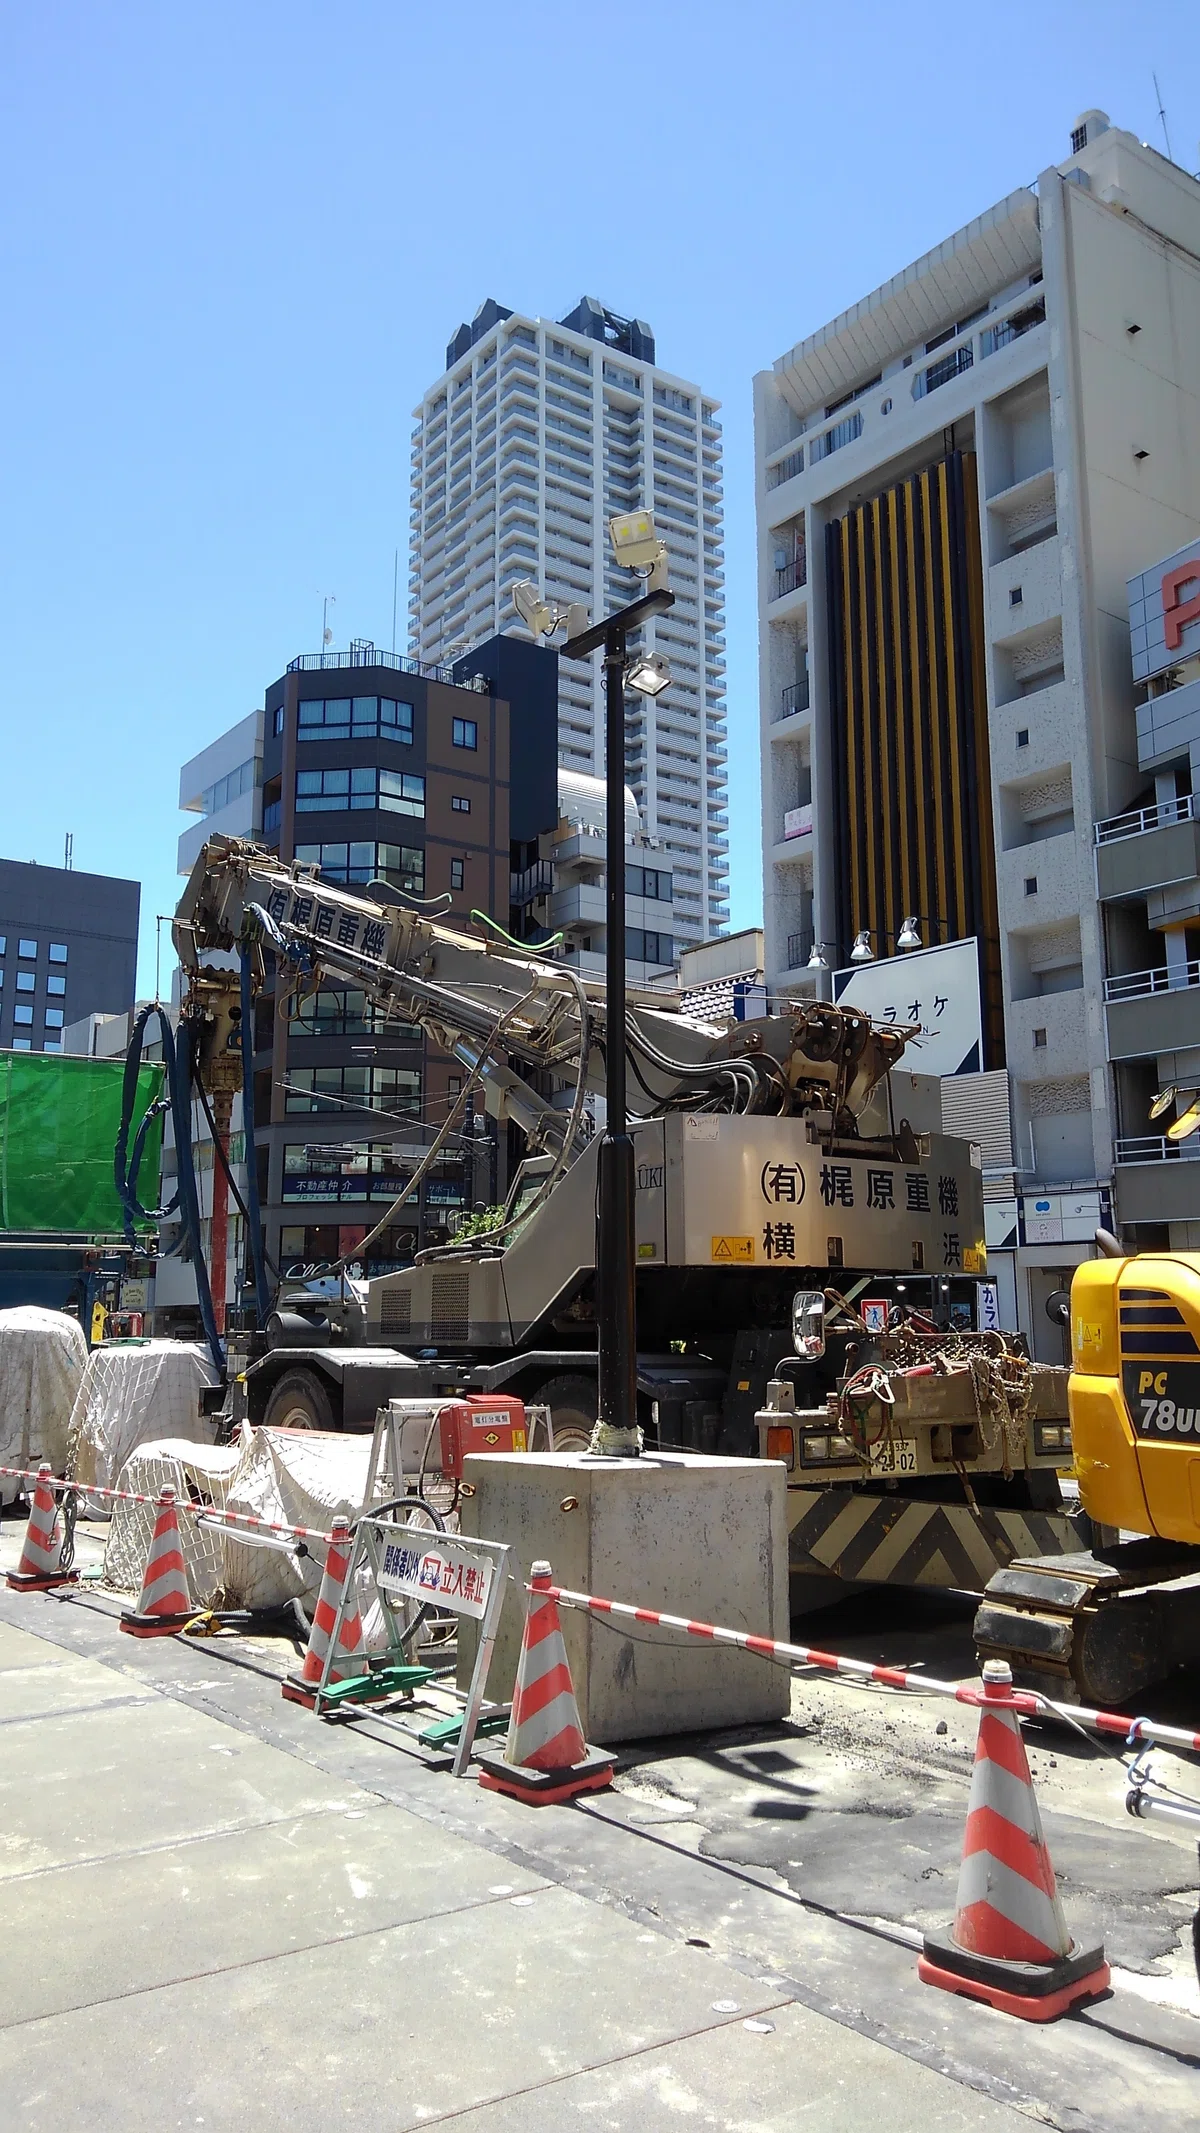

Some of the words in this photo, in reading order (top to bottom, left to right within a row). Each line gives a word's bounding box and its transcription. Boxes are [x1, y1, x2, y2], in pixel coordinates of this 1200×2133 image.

[1139, 1371, 1168, 1395] PC
[440, 1561, 485, 1604] 立入禁止
